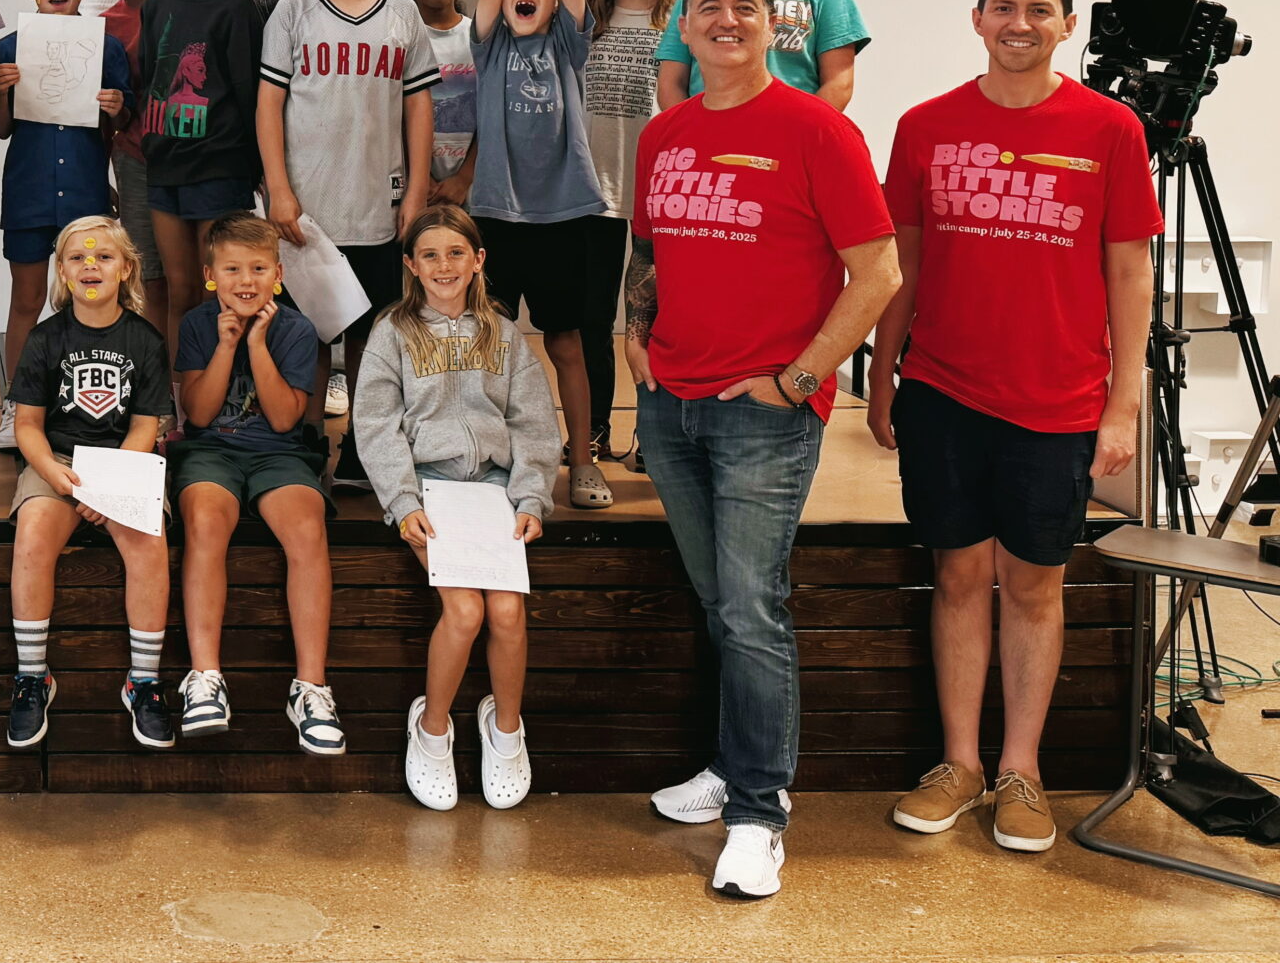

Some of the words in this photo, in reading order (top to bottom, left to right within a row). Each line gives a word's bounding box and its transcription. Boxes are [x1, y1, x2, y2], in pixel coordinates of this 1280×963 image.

[301, 42, 406, 80] JORDAN
[607, 54, 633, 64] YOUR
[635, 57, 661, 67] HERD
[730, 232, 757, 243] 2025
[959, 224, 988, 237] camp
[993, 227, 1015, 239] july
[69, 350, 88, 364] ALL
[91, 349, 125, 365] STARS
[78, 368, 116, 389] FBC
